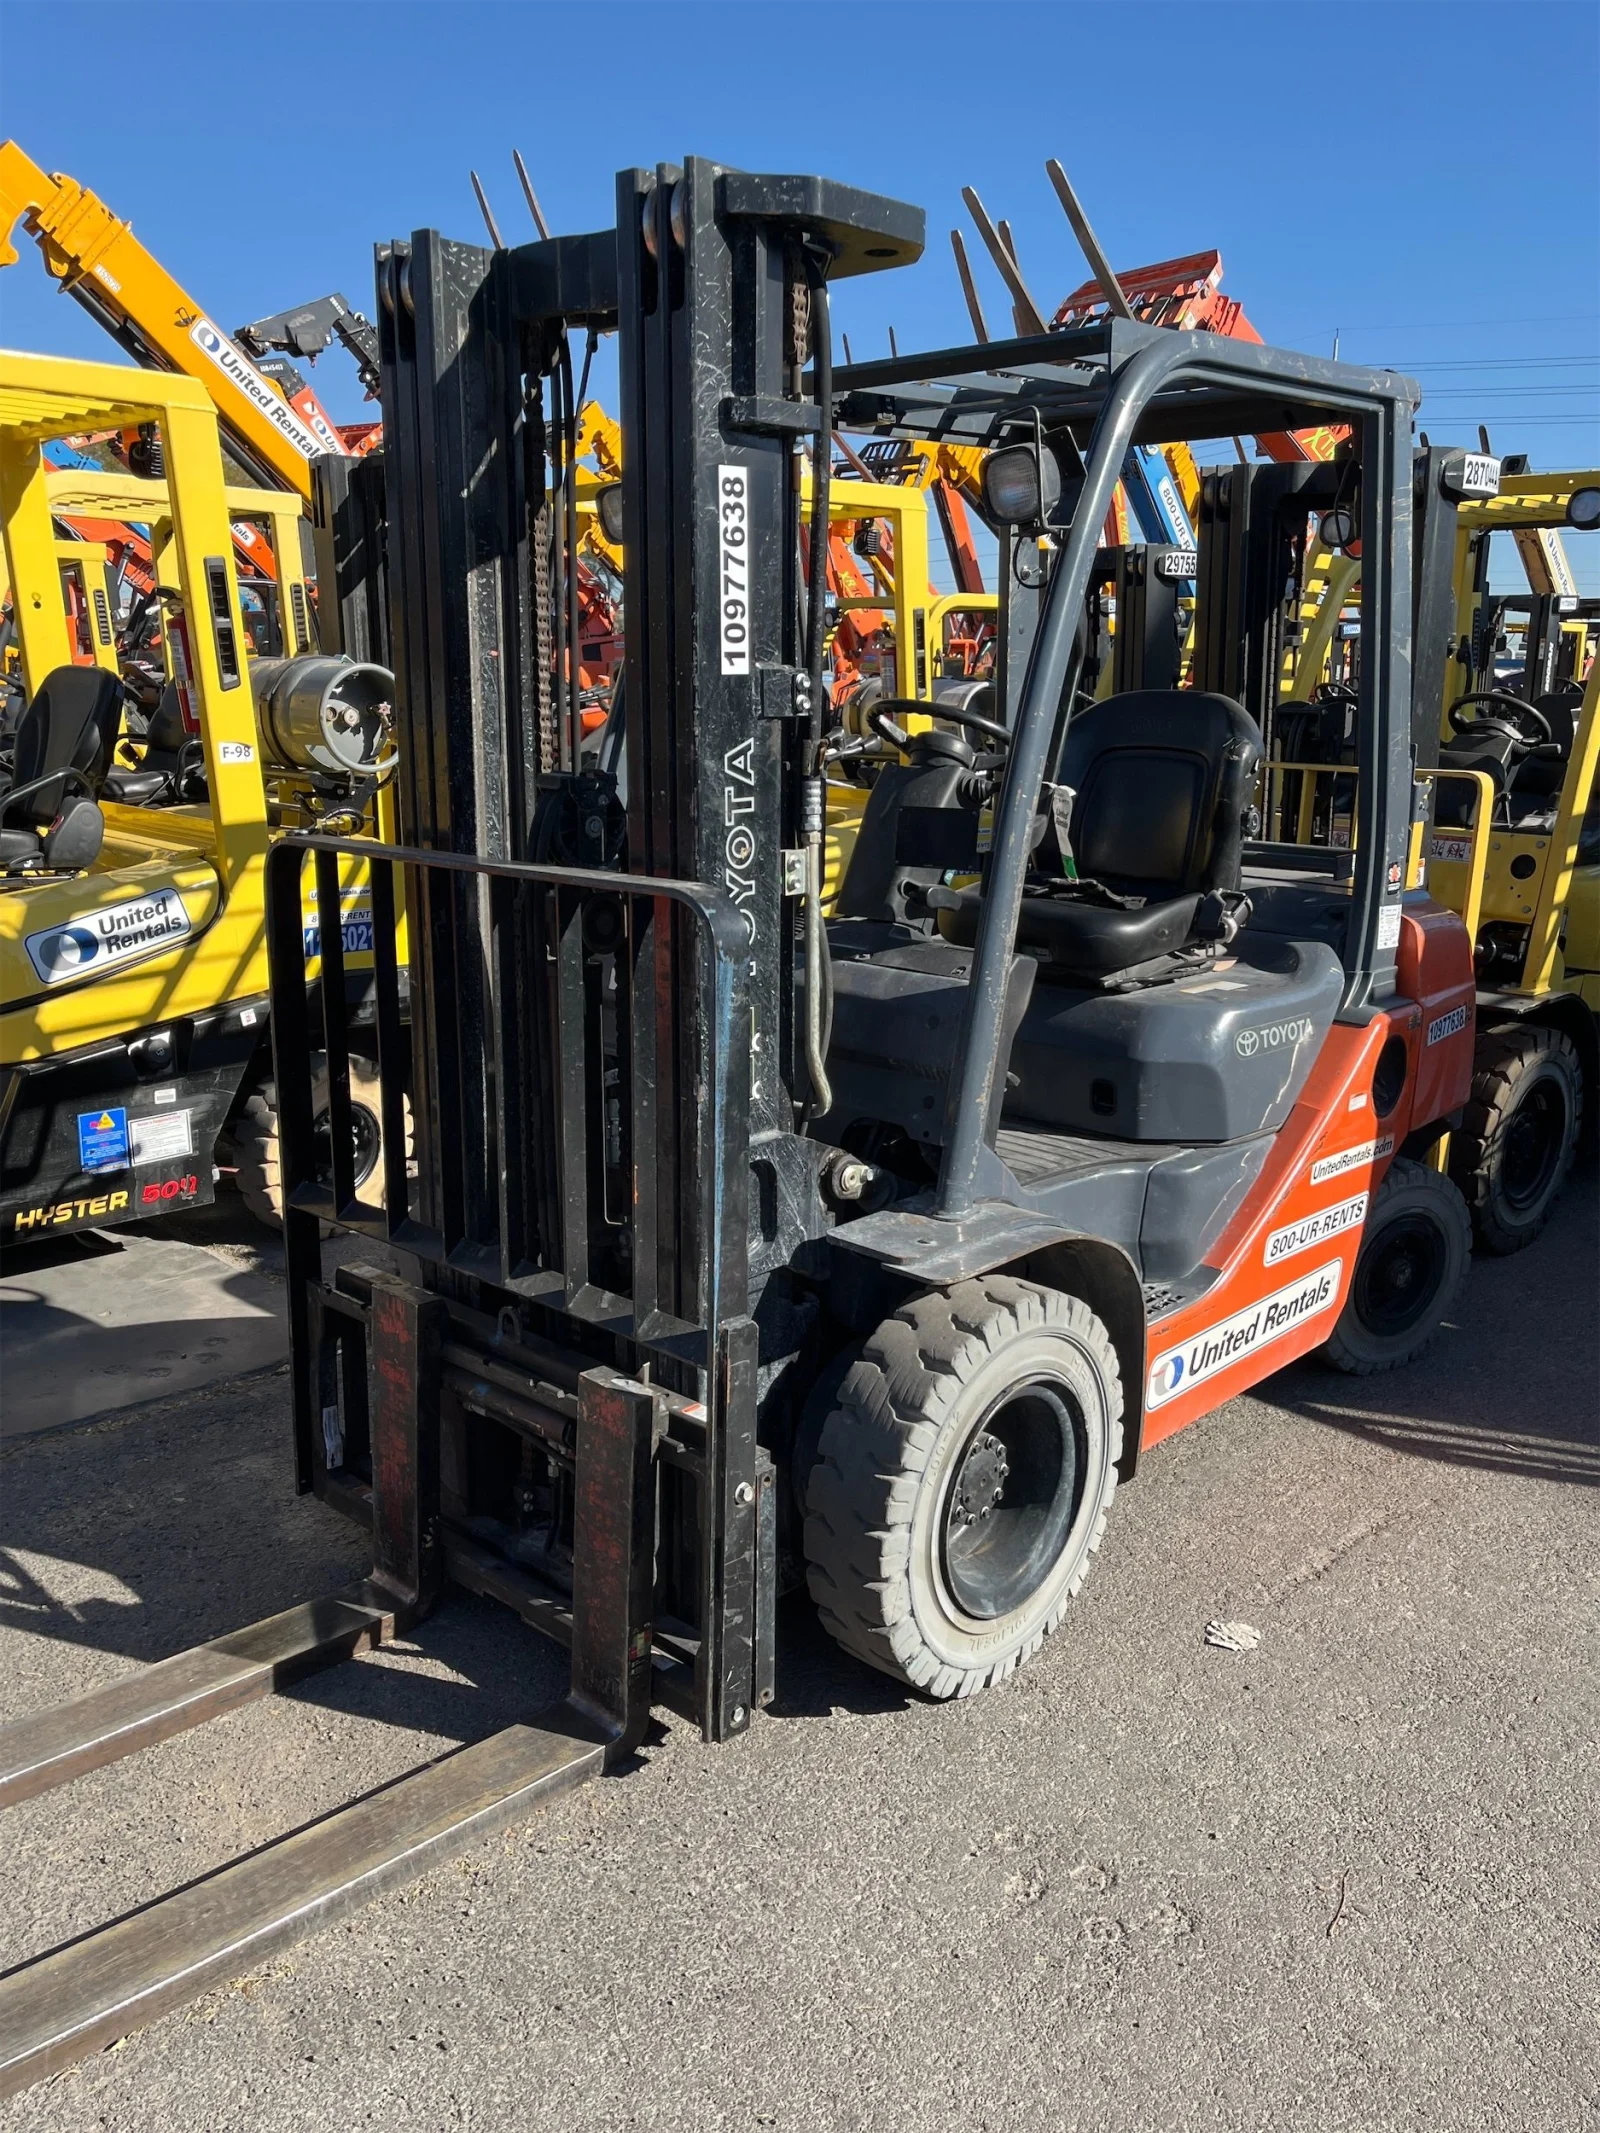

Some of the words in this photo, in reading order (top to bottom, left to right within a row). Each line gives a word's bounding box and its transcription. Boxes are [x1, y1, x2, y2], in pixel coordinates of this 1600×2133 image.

[220, 351, 274, 408] United
[324, 435, 341, 457] Uni
[233, 524, 250, 541] tals
[1163, 487, 1192, 554] 800-UR-R
[722, 476, 746, 667] 10977638
[1166, 555, 1196, 574] 29755
[1551, 545, 1565, 580] United
[222, 745, 251, 758] F-98
[98, 897, 168, 935] United
[105, 915, 181, 954] Rentals
[1260, 1018, 1313, 1048] TOYOTA
[1430, 1008, 1464, 1042] 10977638
[1313, 1136, 1393, 1180] UnitedRentals.com
[15, 1190, 129, 1231] HYSTER
[1270, 1200, 1364, 1257] 800-UR-RENTS
[1188, 1312, 1260, 1377] United
[1262, 1276, 1331, 1335] Rentals
